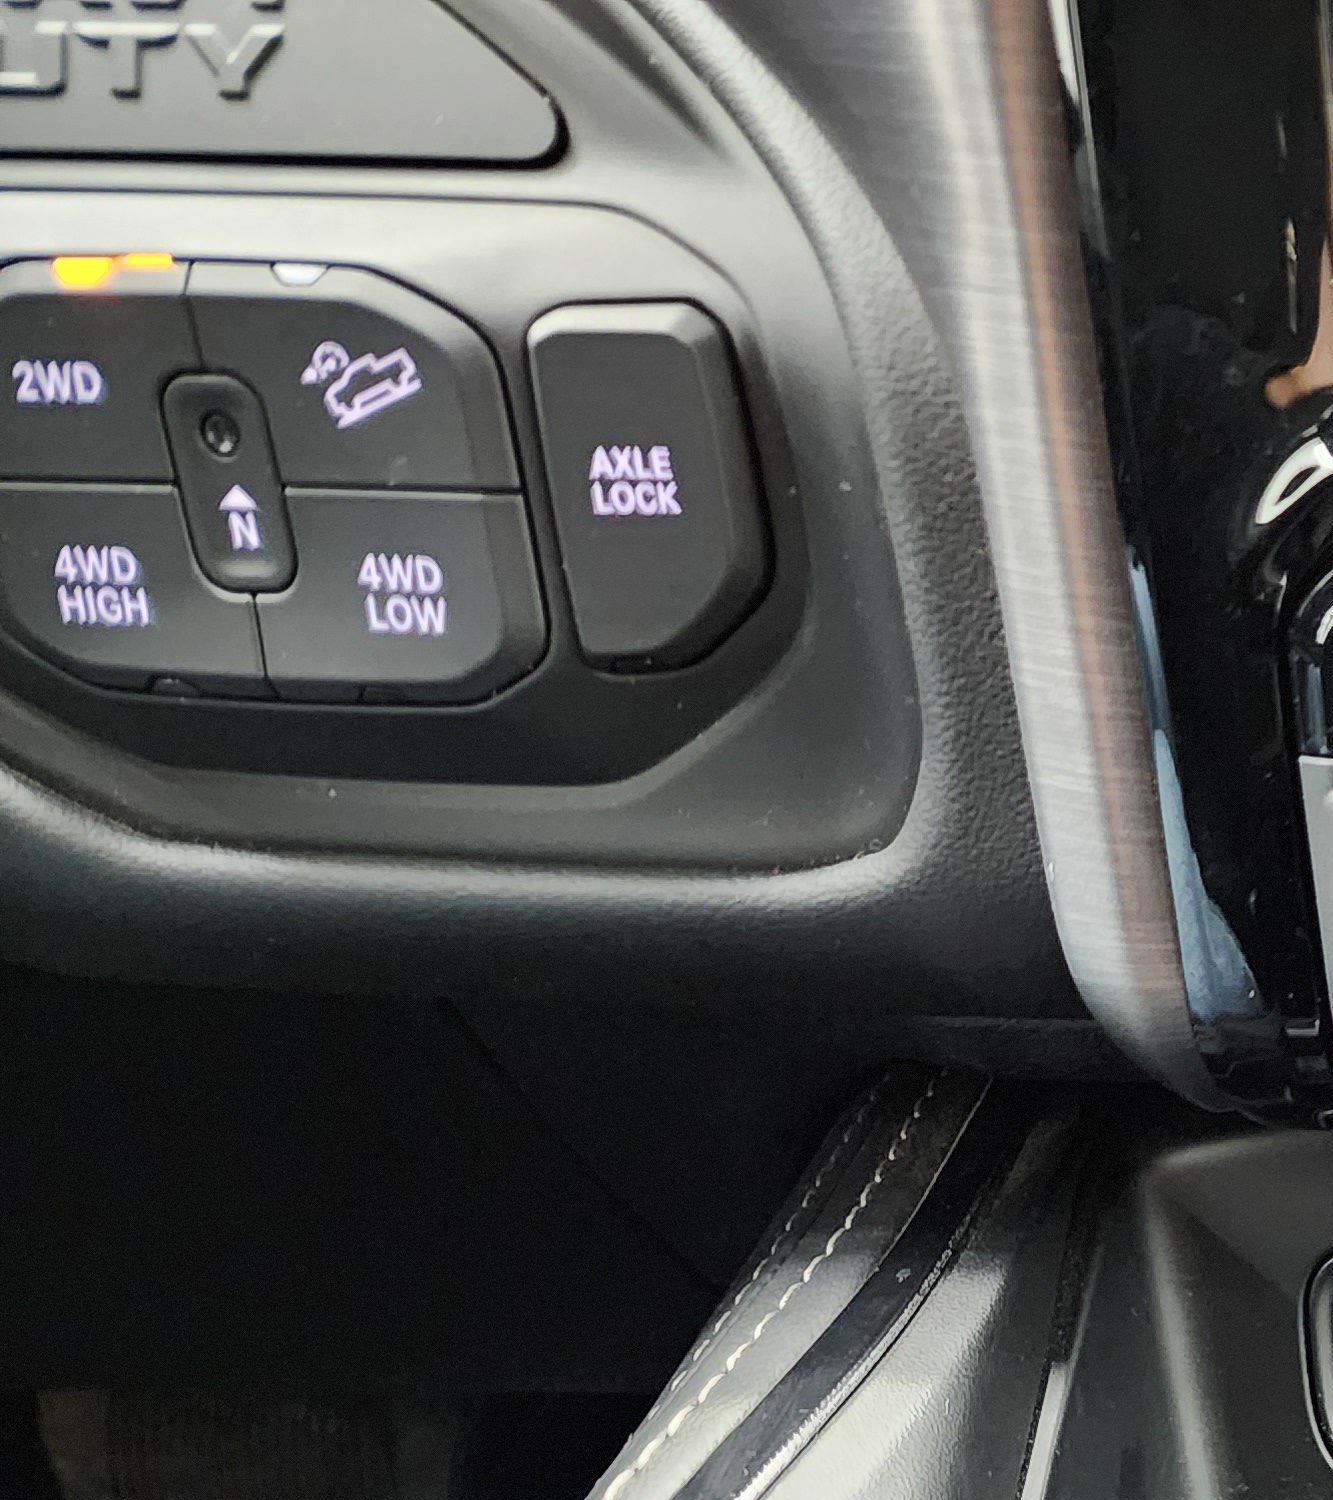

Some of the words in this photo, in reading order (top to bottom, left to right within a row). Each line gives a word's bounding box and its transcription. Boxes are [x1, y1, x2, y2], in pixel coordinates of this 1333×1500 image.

[11, 360, 103, 405] 2WD
[588, 445, 674, 482] AXLE
[590, 479, 683, 516] LOCK
[229, 511, 261, 550] N
[54, 544, 139, 586] 4WD
[357, 552, 444, 594] 4WD
[58, 586, 150, 627] HIGH
[366, 594, 446, 635] LOW
